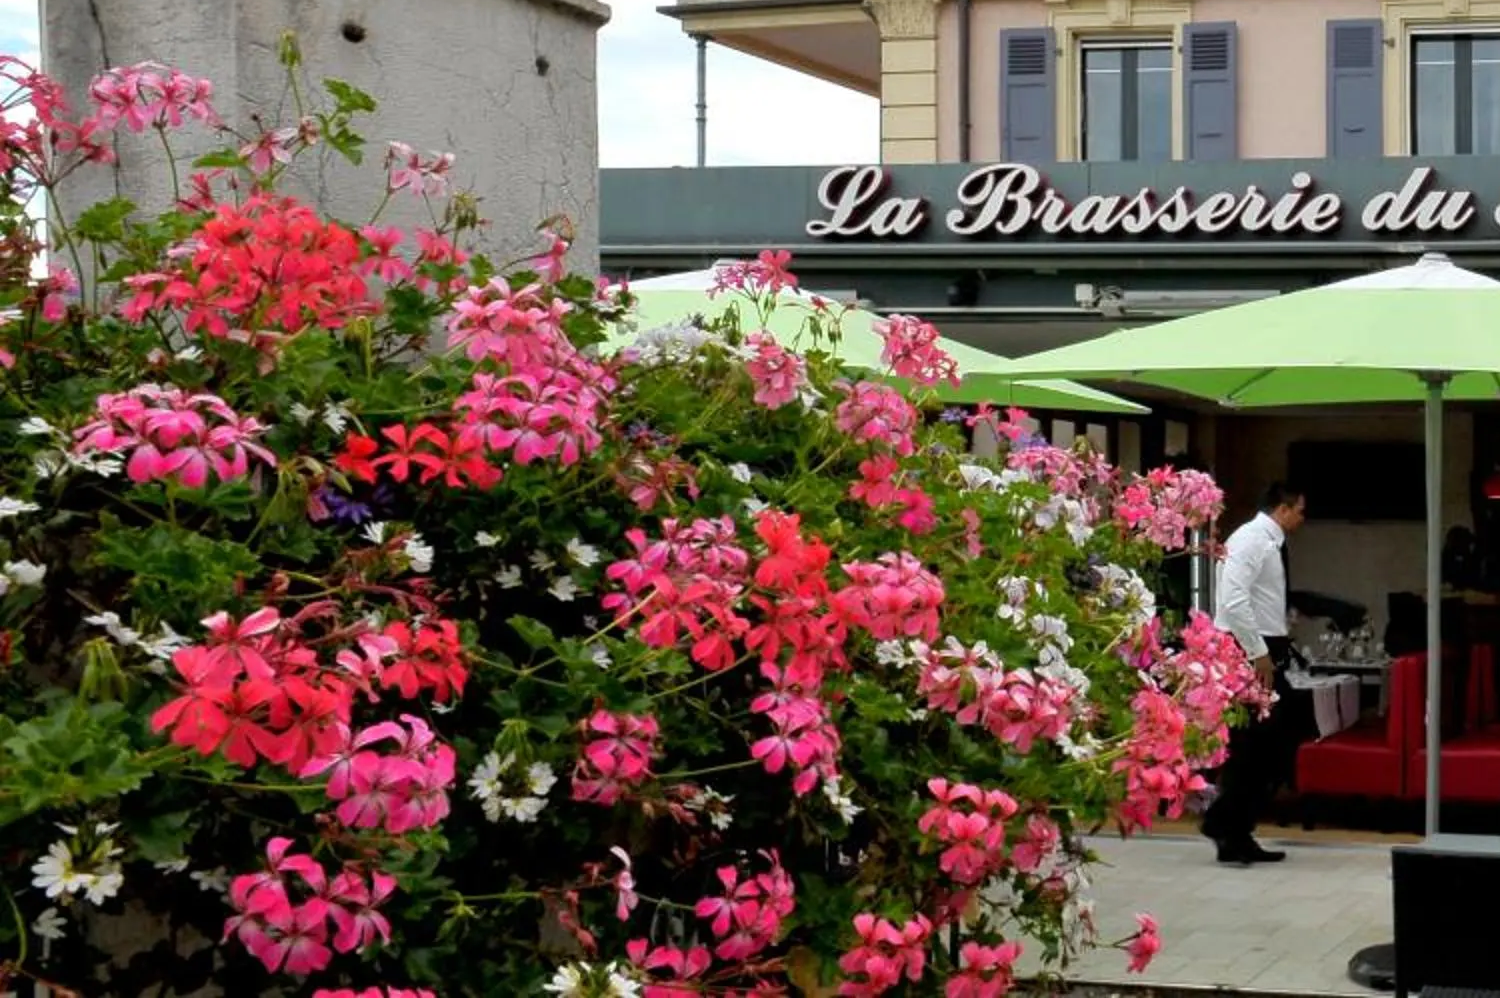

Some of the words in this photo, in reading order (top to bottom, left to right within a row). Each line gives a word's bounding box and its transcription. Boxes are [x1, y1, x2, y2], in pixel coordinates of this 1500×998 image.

[805, 164, 924, 237] La
[945, 162, 1340, 236] Brasserie
[1360, 166, 1476, 232] du
